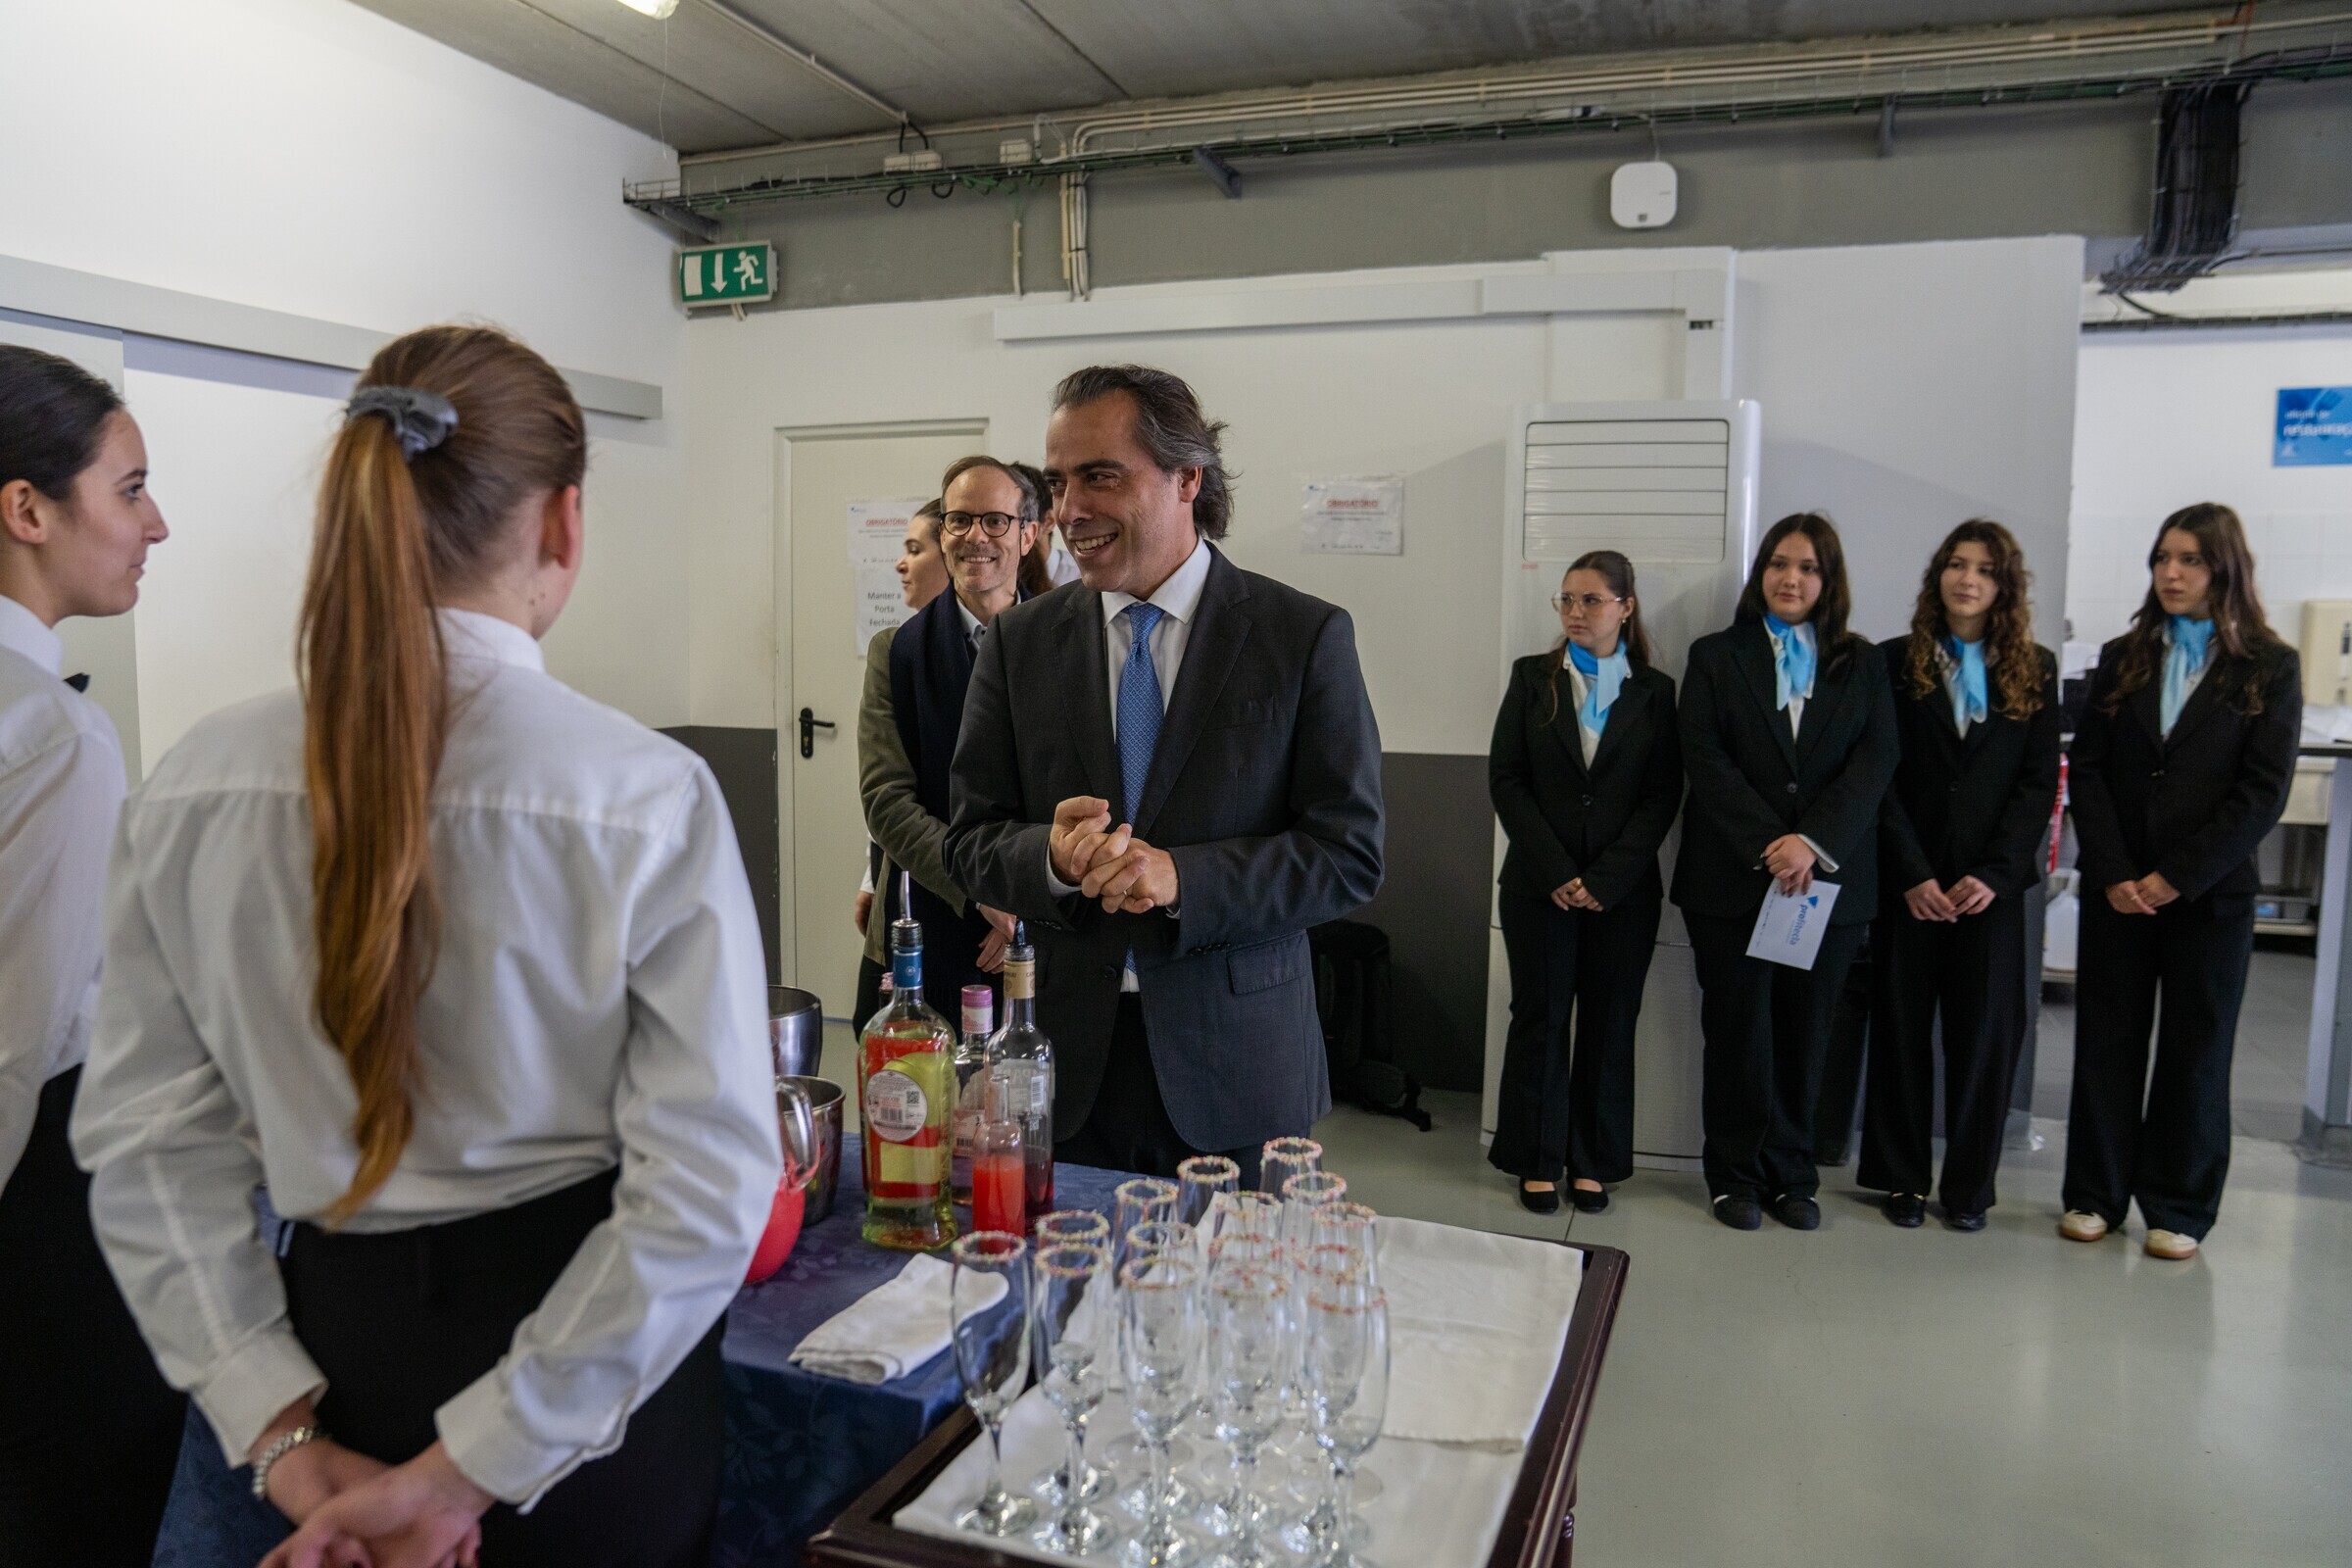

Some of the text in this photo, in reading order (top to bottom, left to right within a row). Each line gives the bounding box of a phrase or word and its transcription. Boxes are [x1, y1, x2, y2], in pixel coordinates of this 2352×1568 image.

[866, 517, 908, 527] OBRIGATÓRIO
[867, 592, 895, 601] Manter
[869, 618, 901, 627] Fechada
